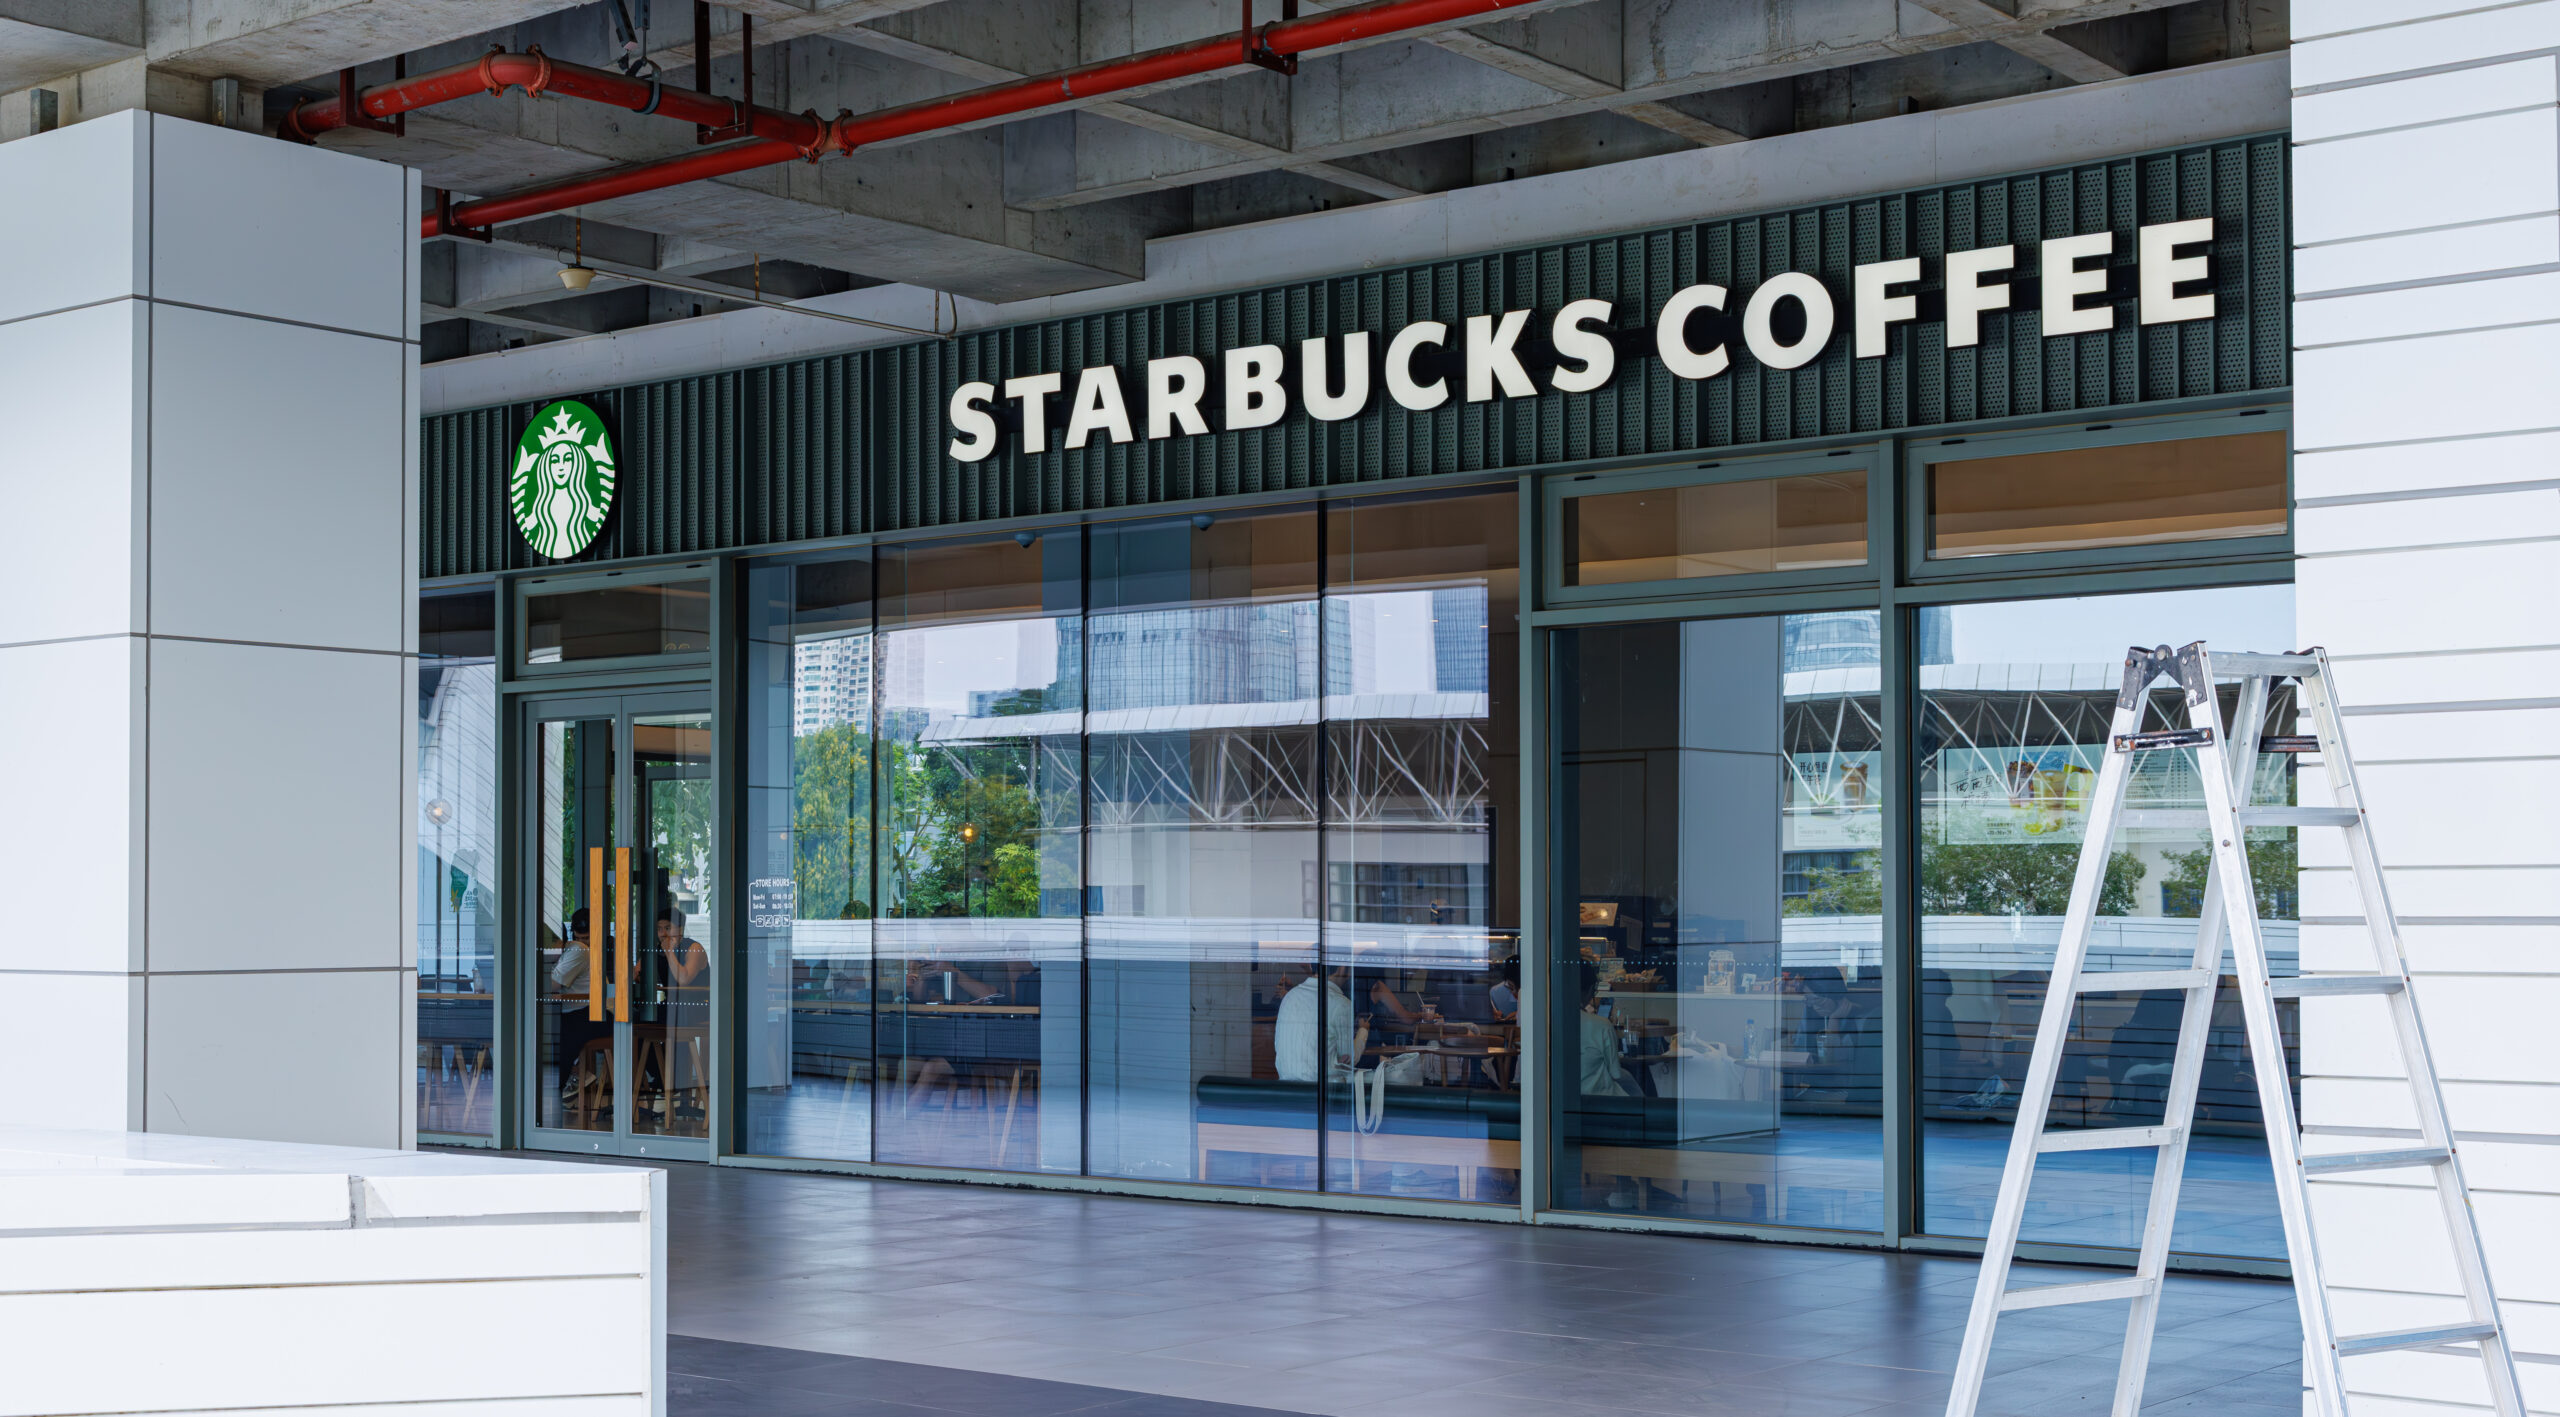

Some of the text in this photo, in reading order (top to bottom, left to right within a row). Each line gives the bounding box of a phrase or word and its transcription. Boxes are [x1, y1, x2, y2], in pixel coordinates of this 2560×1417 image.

[949, 217, 2216, 463] STARBUCKS COFFEE
[755, 878, 790, 888] STORE HOURS
